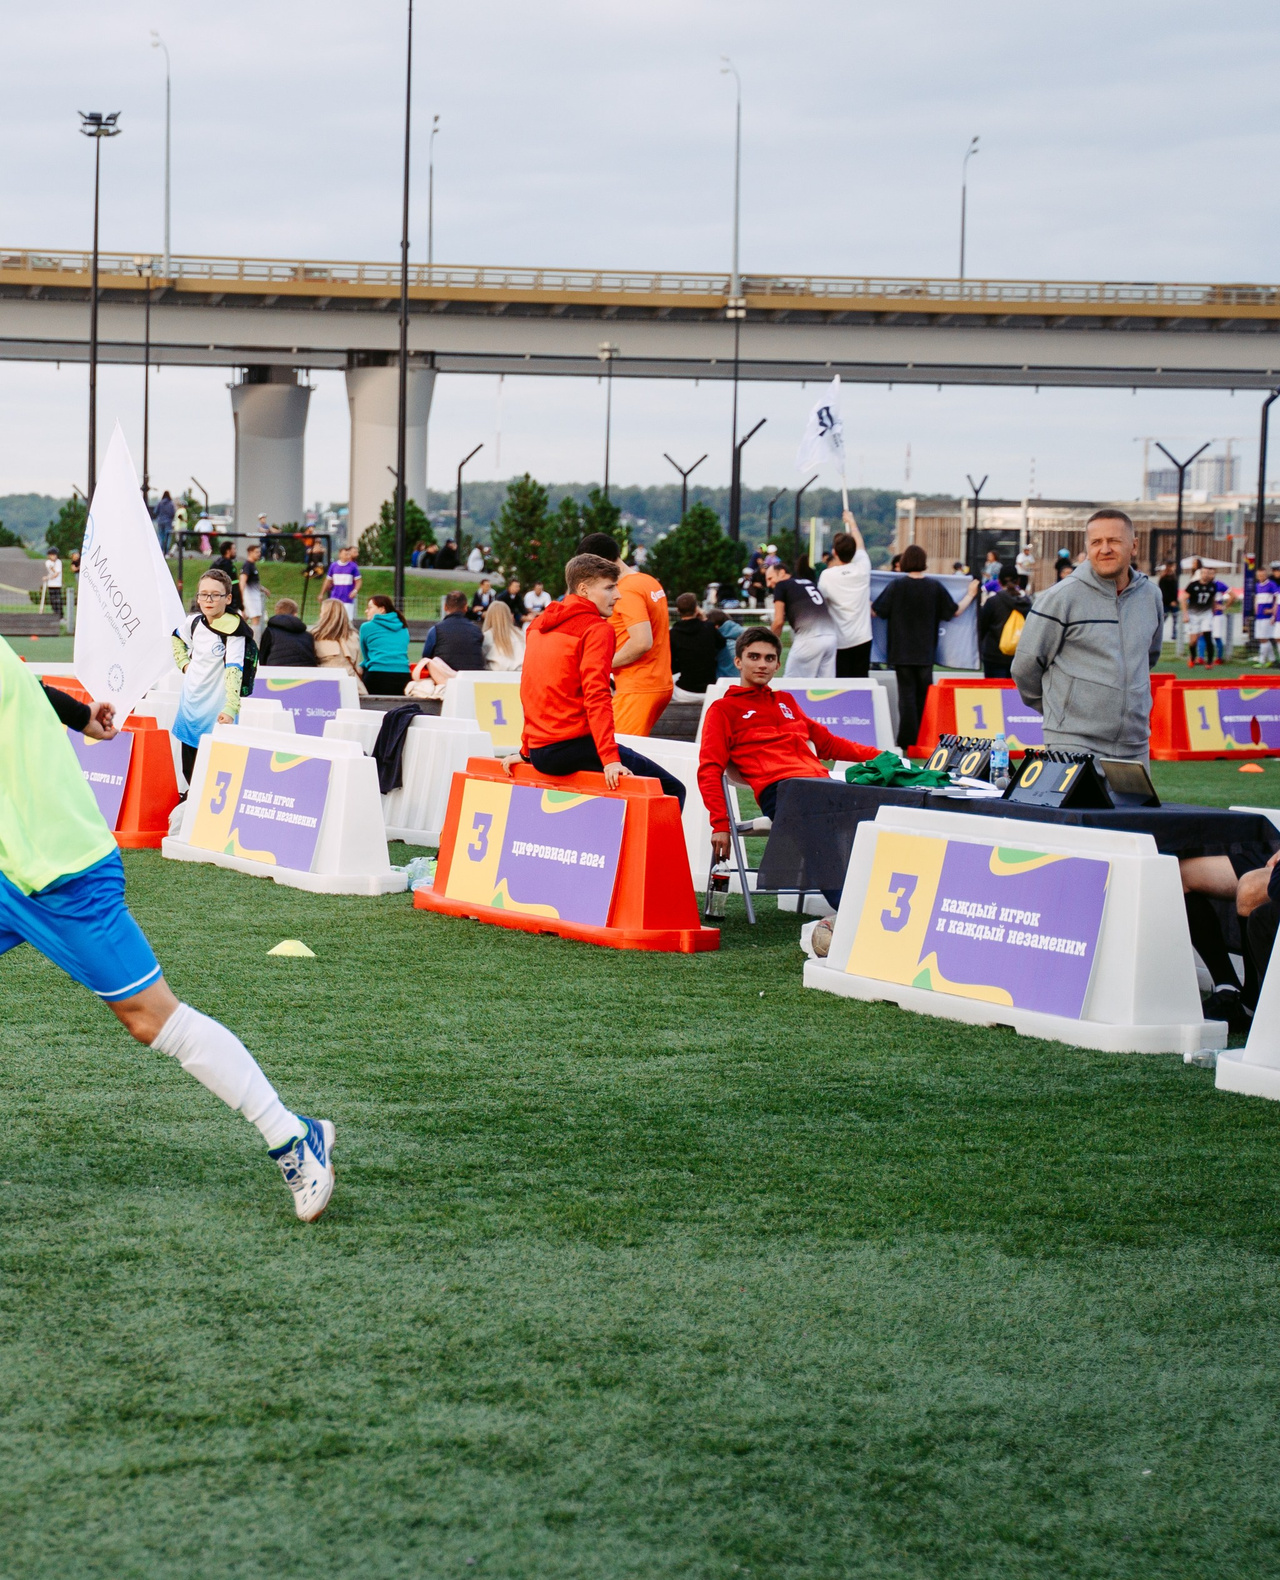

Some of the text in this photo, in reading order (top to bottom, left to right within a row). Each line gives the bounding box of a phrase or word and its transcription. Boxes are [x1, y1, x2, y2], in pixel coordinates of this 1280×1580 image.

[90, 545, 141, 638] Микорд
[805, 586, 823, 605] 5
[491, 699, 507, 725] 1
[842, 716, 871, 725] Skillbox
[973, 705, 987, 729] 1
[1198, 706, 1210, 730] 1
[929, 749, 948, 771] 0
[960, 751, 981, 775] 0
[1020, 760, 1078, 792] 0 1
[210, 771, 232, 815] 3
[467, 811, 493, 862] 3
[579, 852, 606, 868] 2024
[880, 872, 918, 932] 3
